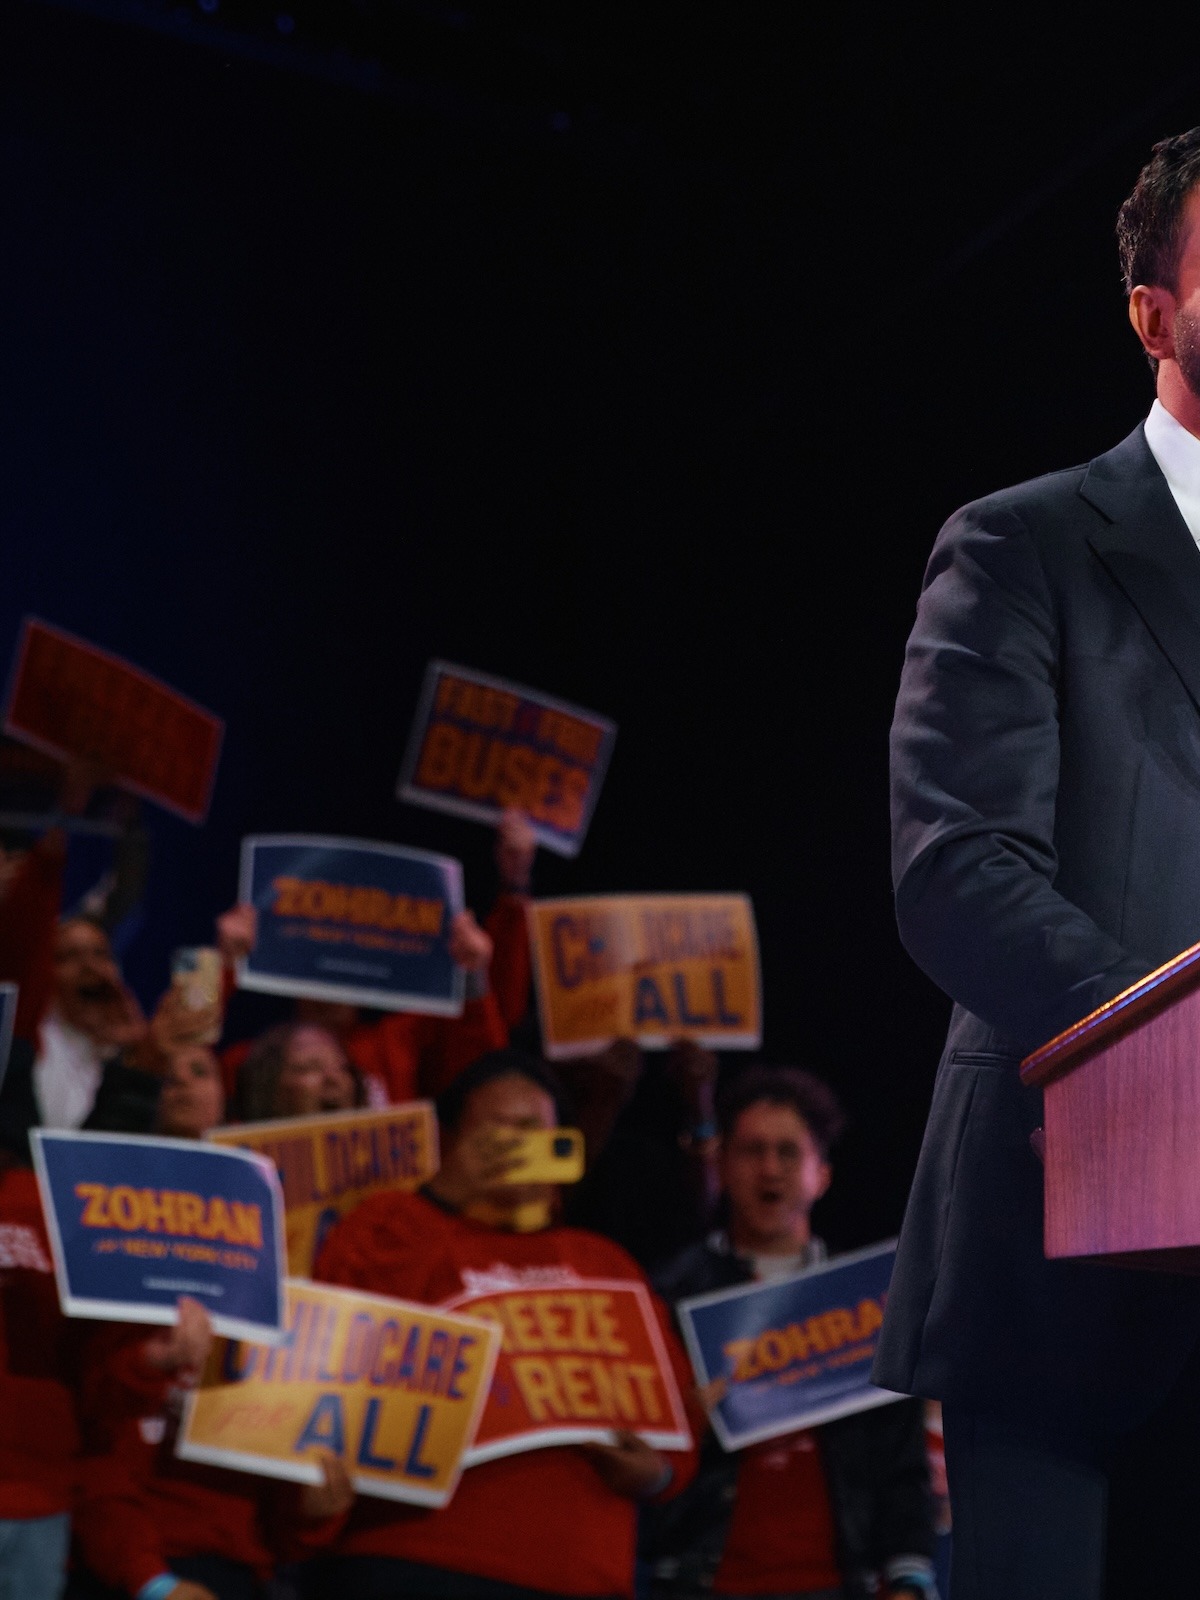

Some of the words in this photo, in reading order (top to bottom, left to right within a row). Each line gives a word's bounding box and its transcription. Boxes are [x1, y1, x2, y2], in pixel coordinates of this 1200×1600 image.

[632, 966, 742, 1027] ALL
[73, 1181, 264, 1249] ZOHRAN
[466, 1292, 629, 1356] REEZE
[722, 1292, 888, 1383] ZOHRA
[511, 1356, 664, 1423] RENT
[293, 1392, 437, 1480] ALL
